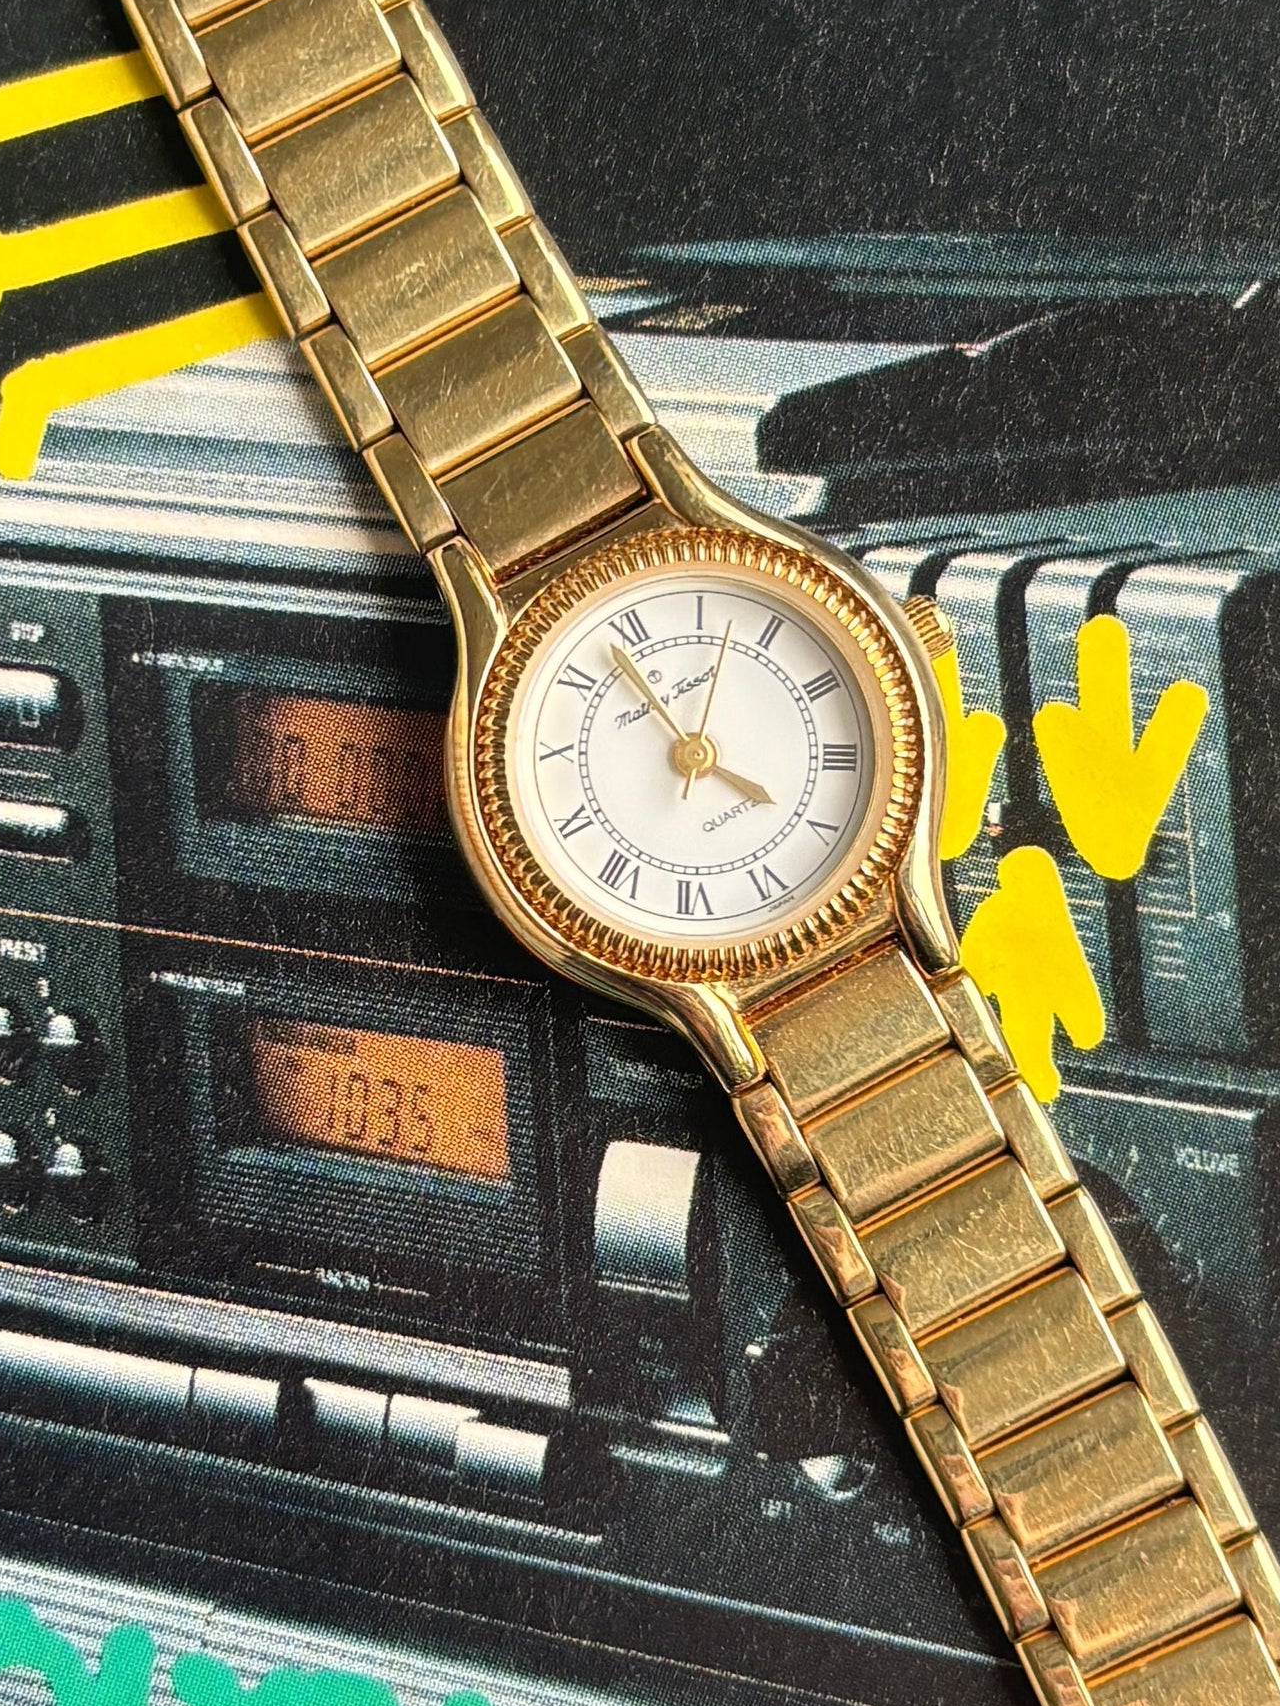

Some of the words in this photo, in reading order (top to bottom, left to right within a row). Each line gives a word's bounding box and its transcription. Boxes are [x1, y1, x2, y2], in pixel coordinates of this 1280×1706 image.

[756, 614, 785, 651] II
[556, 663, 598, 701] XI
[801, 668, 841, 704] III
[538, 741, 576, 764] X
[553, 803, 596, 841] IX
[805, 818, 840, 848] V
[675, 879, 715, 916] VII
[745, 863, 791, 902] VI
